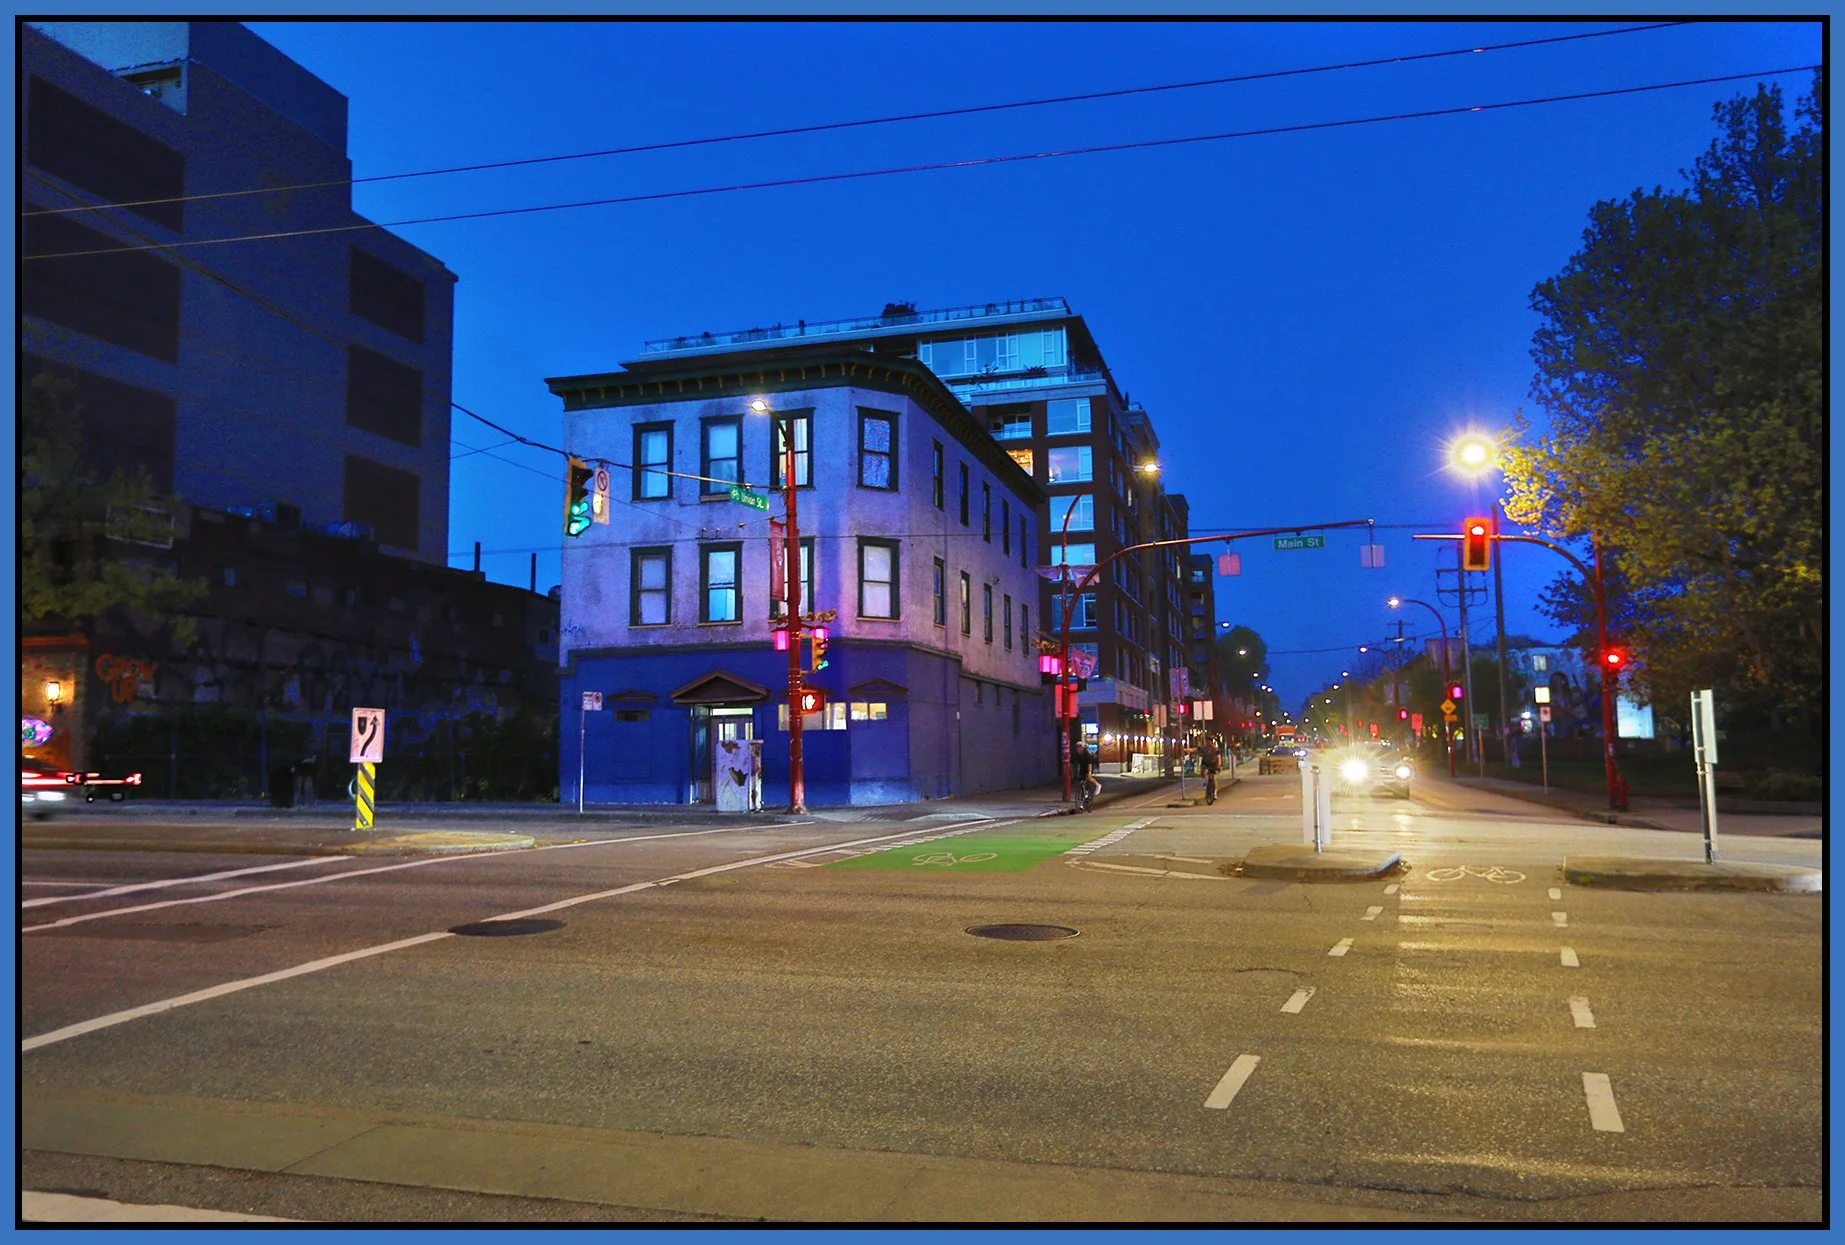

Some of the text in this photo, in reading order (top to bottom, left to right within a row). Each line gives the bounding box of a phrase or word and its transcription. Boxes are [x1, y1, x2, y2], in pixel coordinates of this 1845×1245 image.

[741, 491, 756, 505] Union
[1278, 537, 1320, 549] Main St
[112, 679, 138, 704] UP
